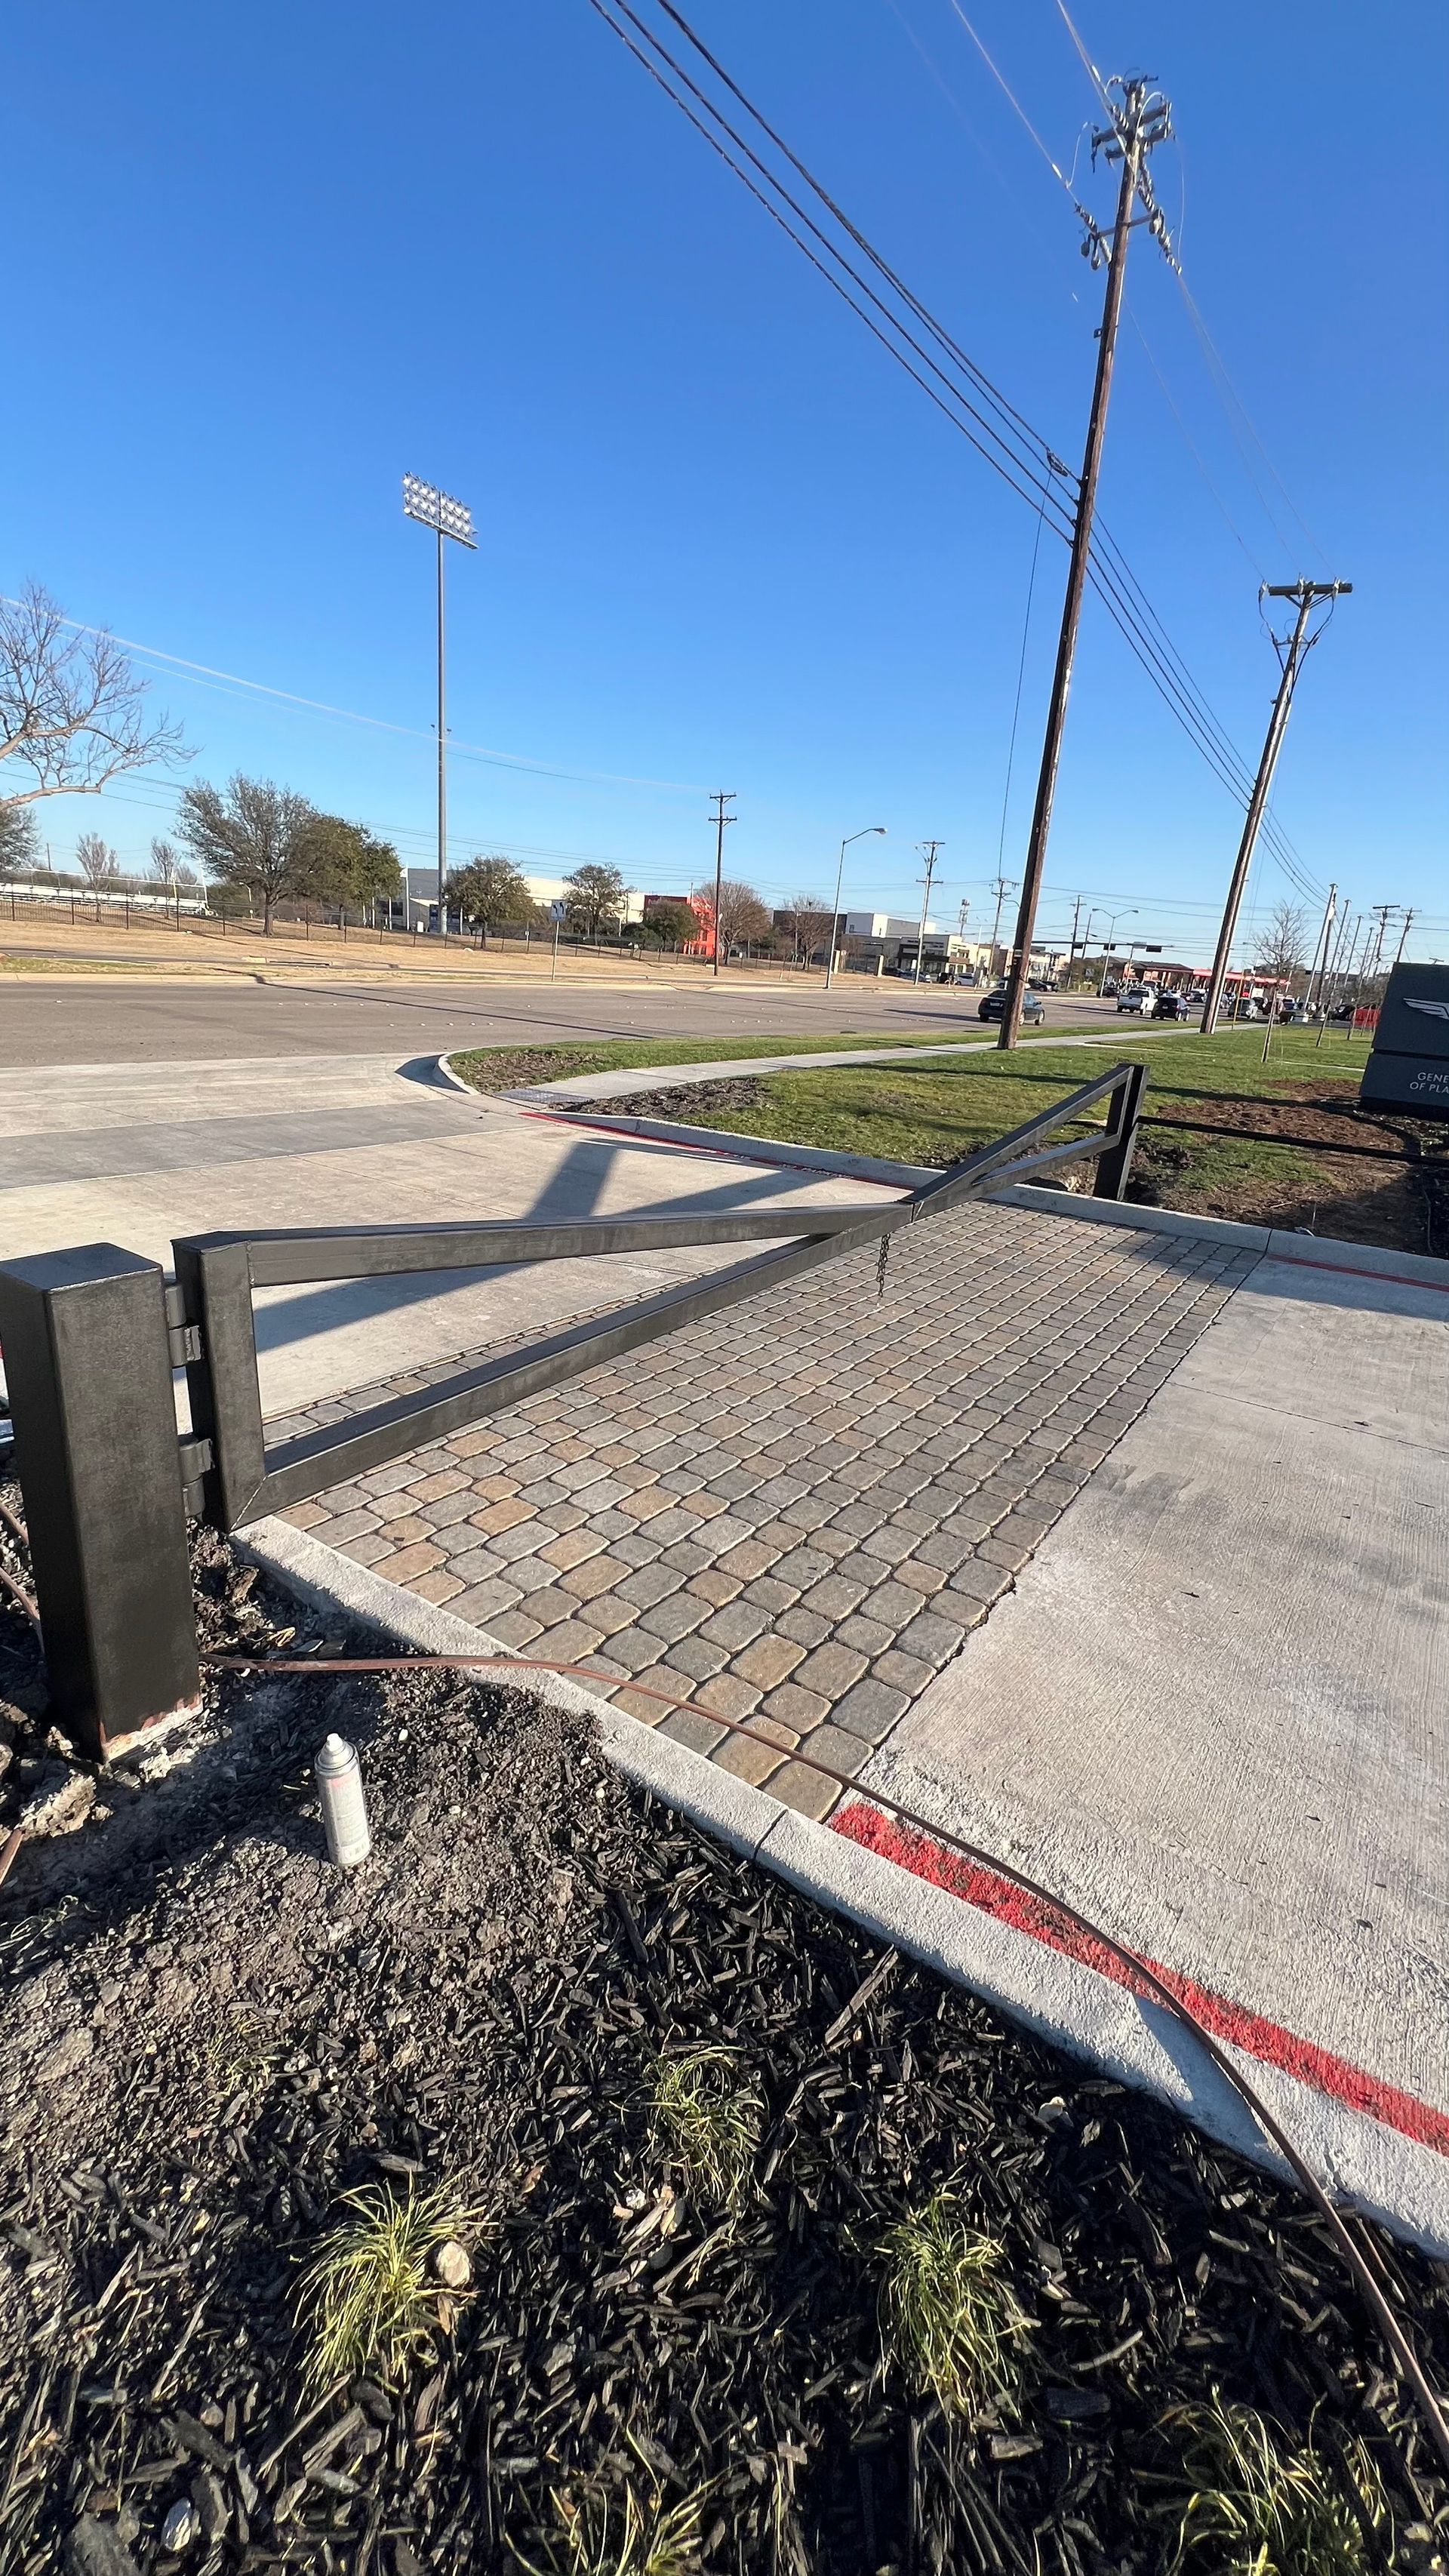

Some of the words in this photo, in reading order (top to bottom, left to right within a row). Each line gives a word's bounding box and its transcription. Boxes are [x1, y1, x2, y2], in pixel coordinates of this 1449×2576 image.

[1417, 1072, 1449, 1083] GENE
[1410, 1082, 1426, 1091] OF
[1429, 1084, 1449, 1094] PLA
